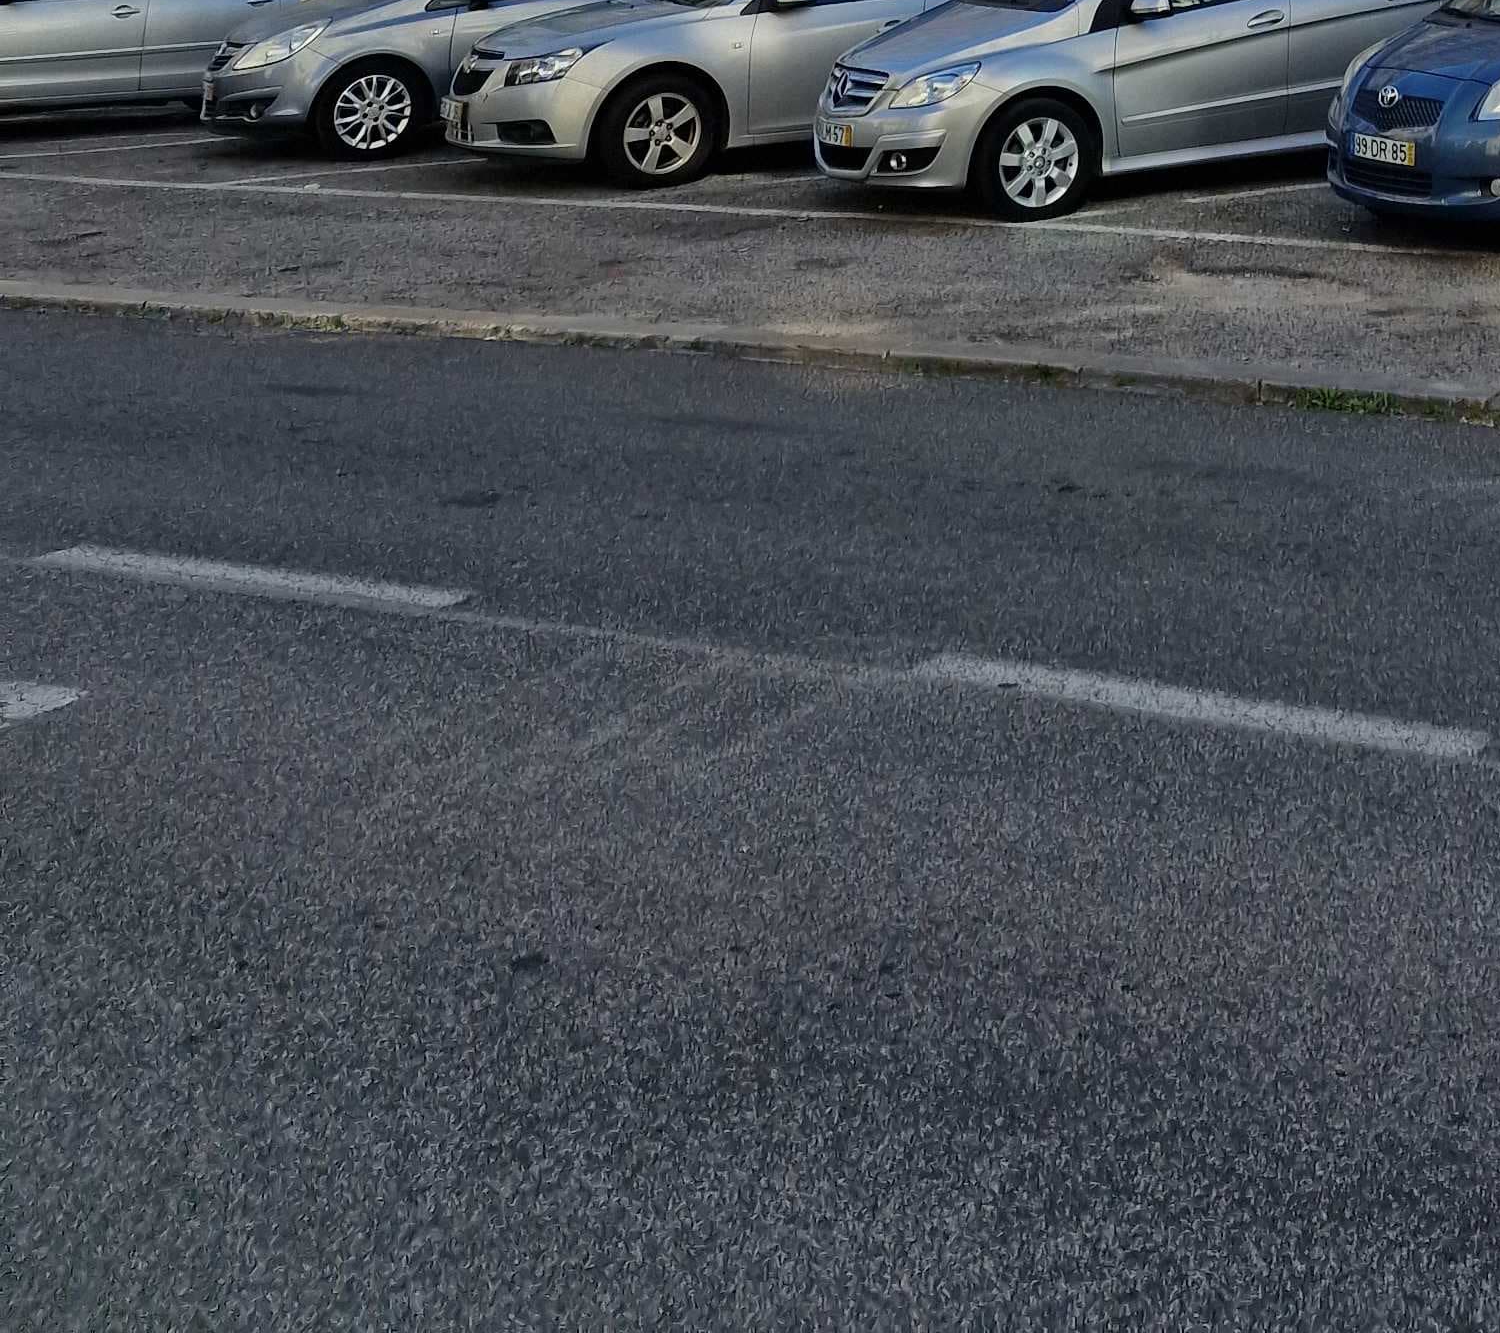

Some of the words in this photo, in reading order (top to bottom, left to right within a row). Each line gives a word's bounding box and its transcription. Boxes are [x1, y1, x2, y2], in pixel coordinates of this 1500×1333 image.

[833, 125, 845, 143] 57
[1355, 135, 1367, 155] 99
[1371, 139, 1387, 159] DR
[1391, 143, 1406, 162] 85
